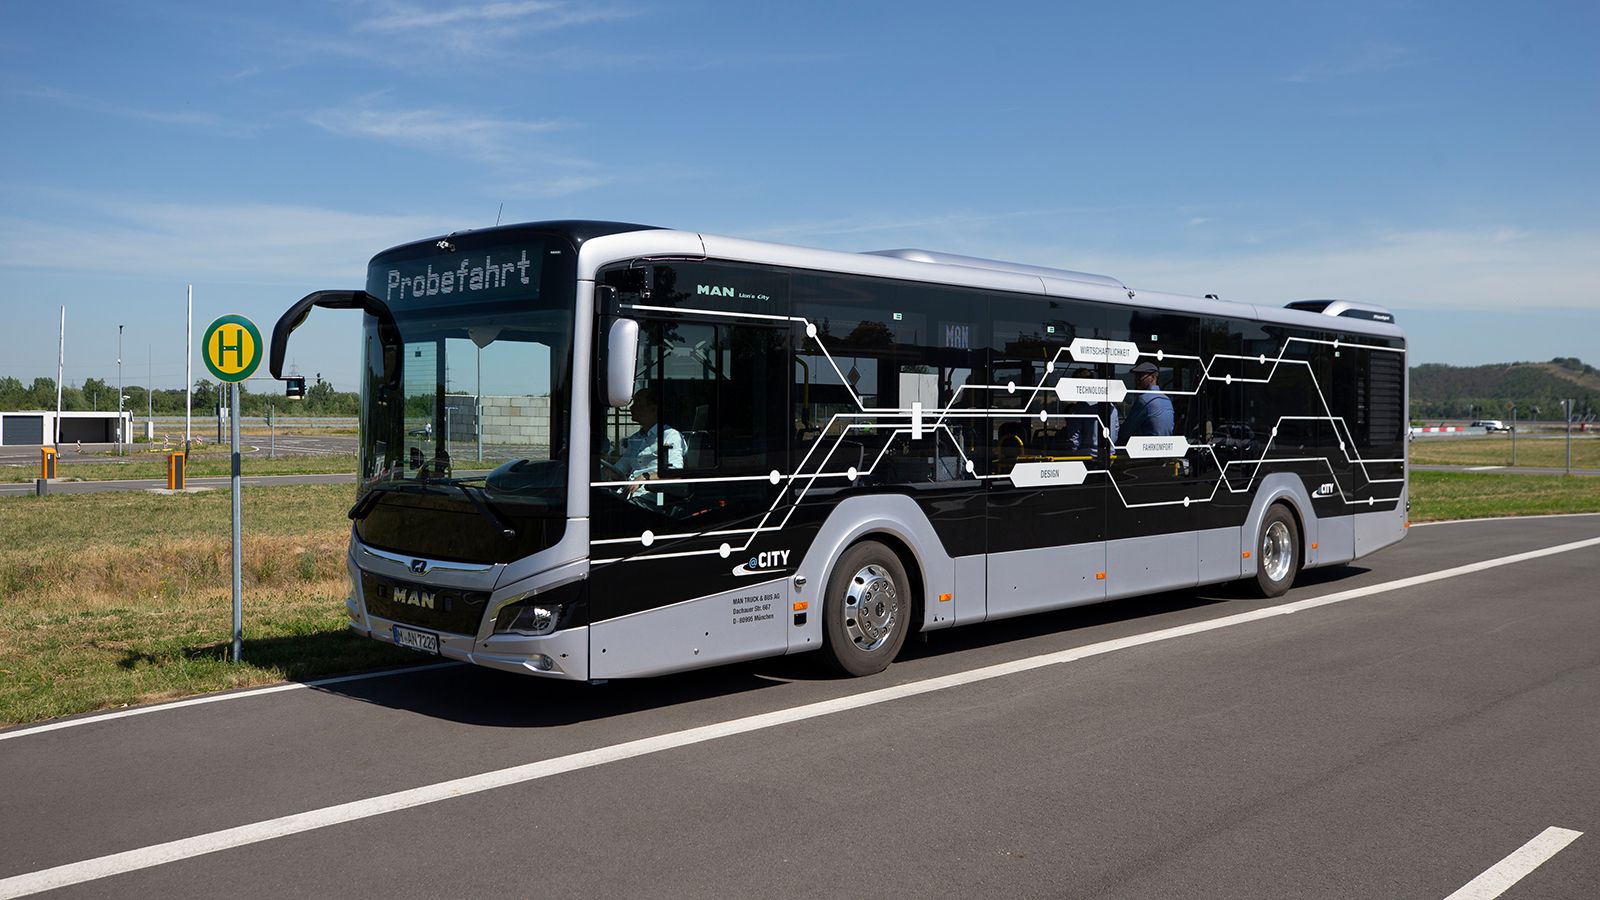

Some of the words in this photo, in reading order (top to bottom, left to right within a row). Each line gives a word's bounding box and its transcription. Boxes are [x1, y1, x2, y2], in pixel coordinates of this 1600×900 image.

[387, 250, 530, 301] Probefahrt
[697, 284, 735, 298] MAN
[757, 293, 770, 301] City
[218, 329, 243, 367] H
[1080, 345, 1131, 357] WIRTSCHAFTLICHKEIT
[1076, 385, 1109, 395] TECHNOLOGIE
[1040, 469, 1060, 479] DESIGN
[393, 586, 436, 609] MAN
[744, 595, 759, 604] TRUCK
[764, 593, 773, 601] BUS
